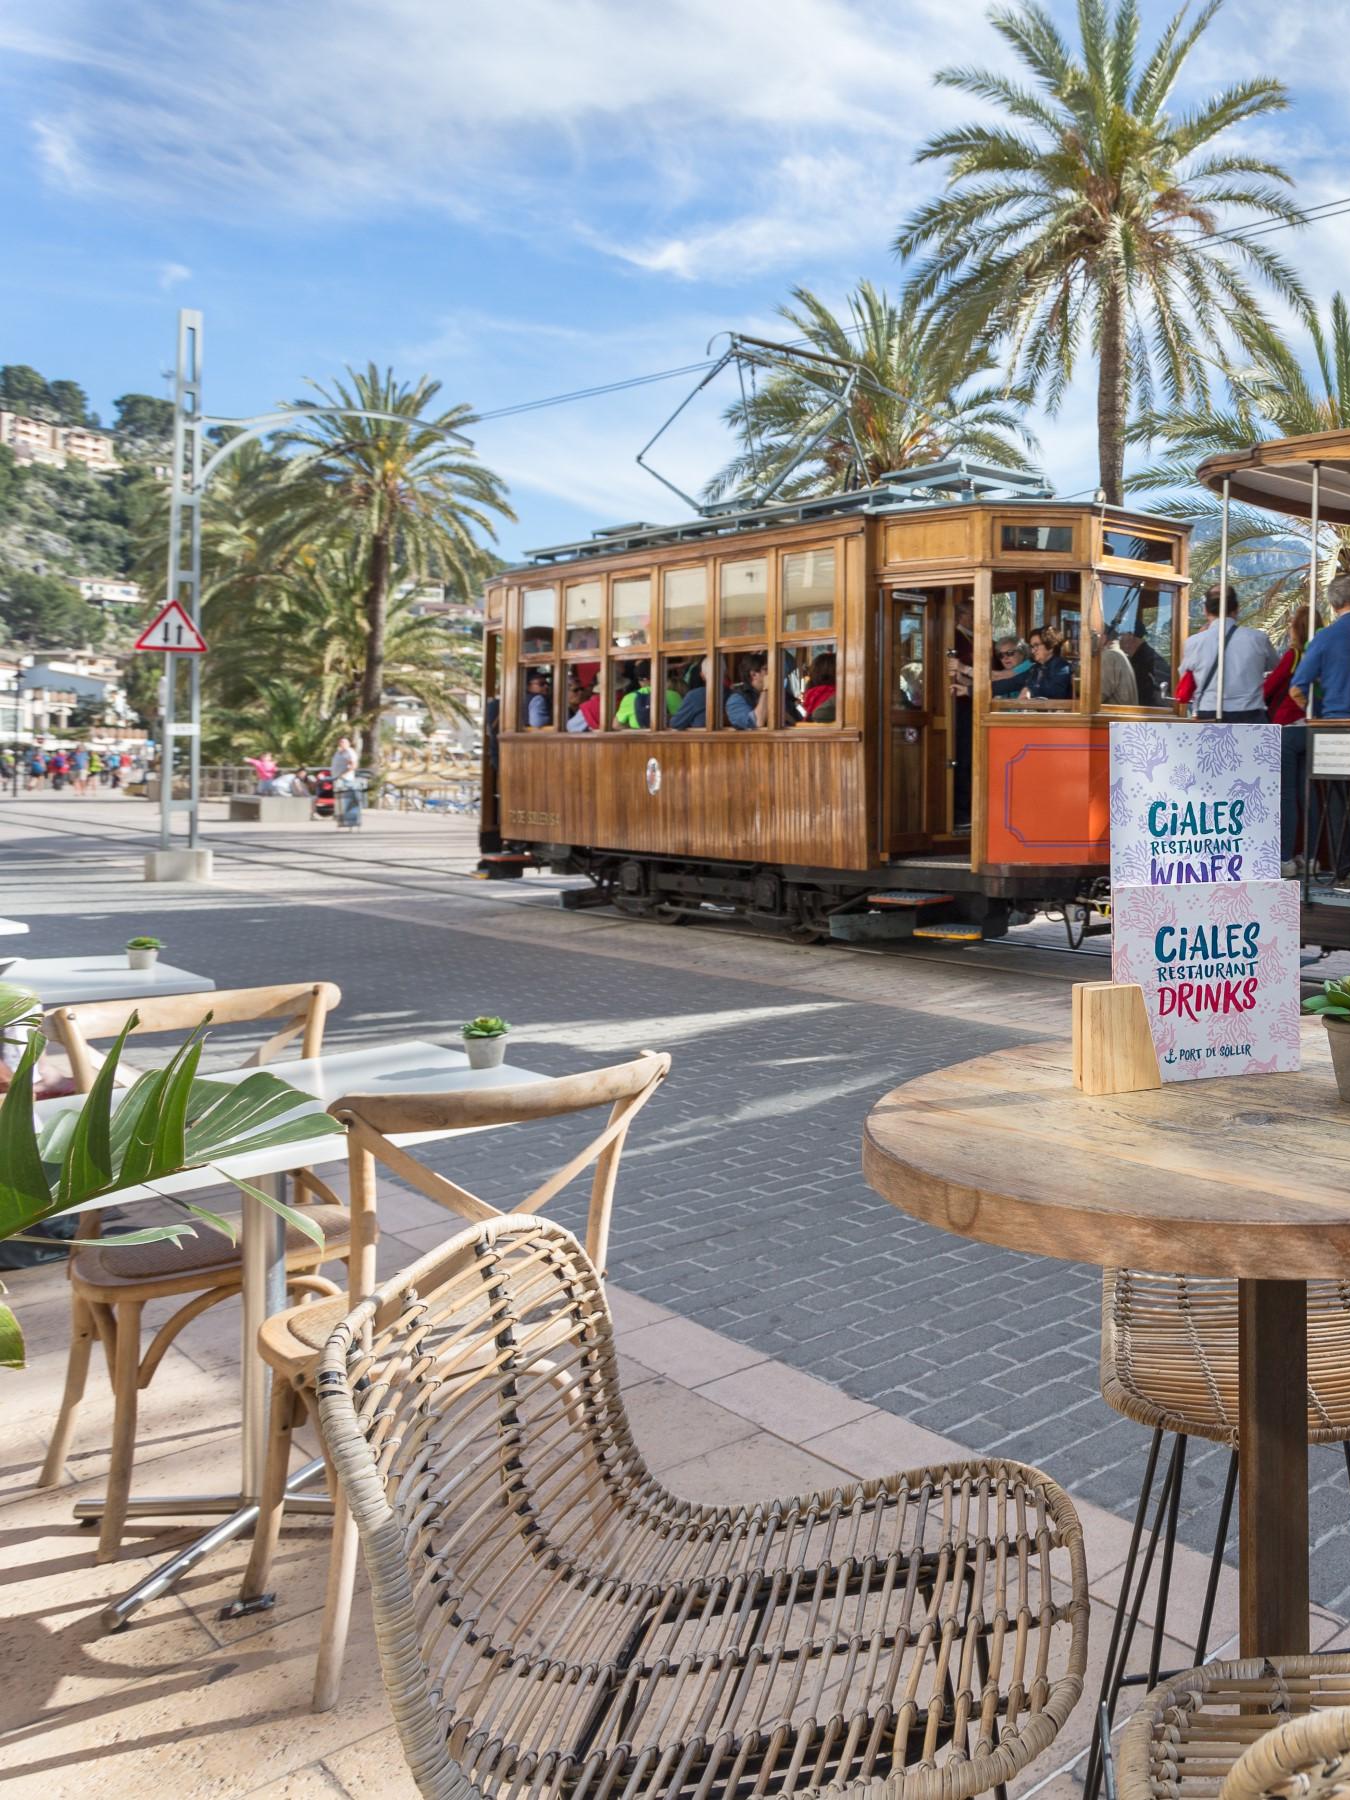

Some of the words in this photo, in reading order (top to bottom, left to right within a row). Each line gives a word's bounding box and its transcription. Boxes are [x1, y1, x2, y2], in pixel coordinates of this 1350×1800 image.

[1150, 838, 1243, 856] RESTAURANT
[1157, 961, 1258, 982] RESTAURANT
[1157, 977, 1258, 1022] DRINKS
[1179, 1048, 1202, 1061] PORT
[1206, 1046, 1216, 1058] DE
